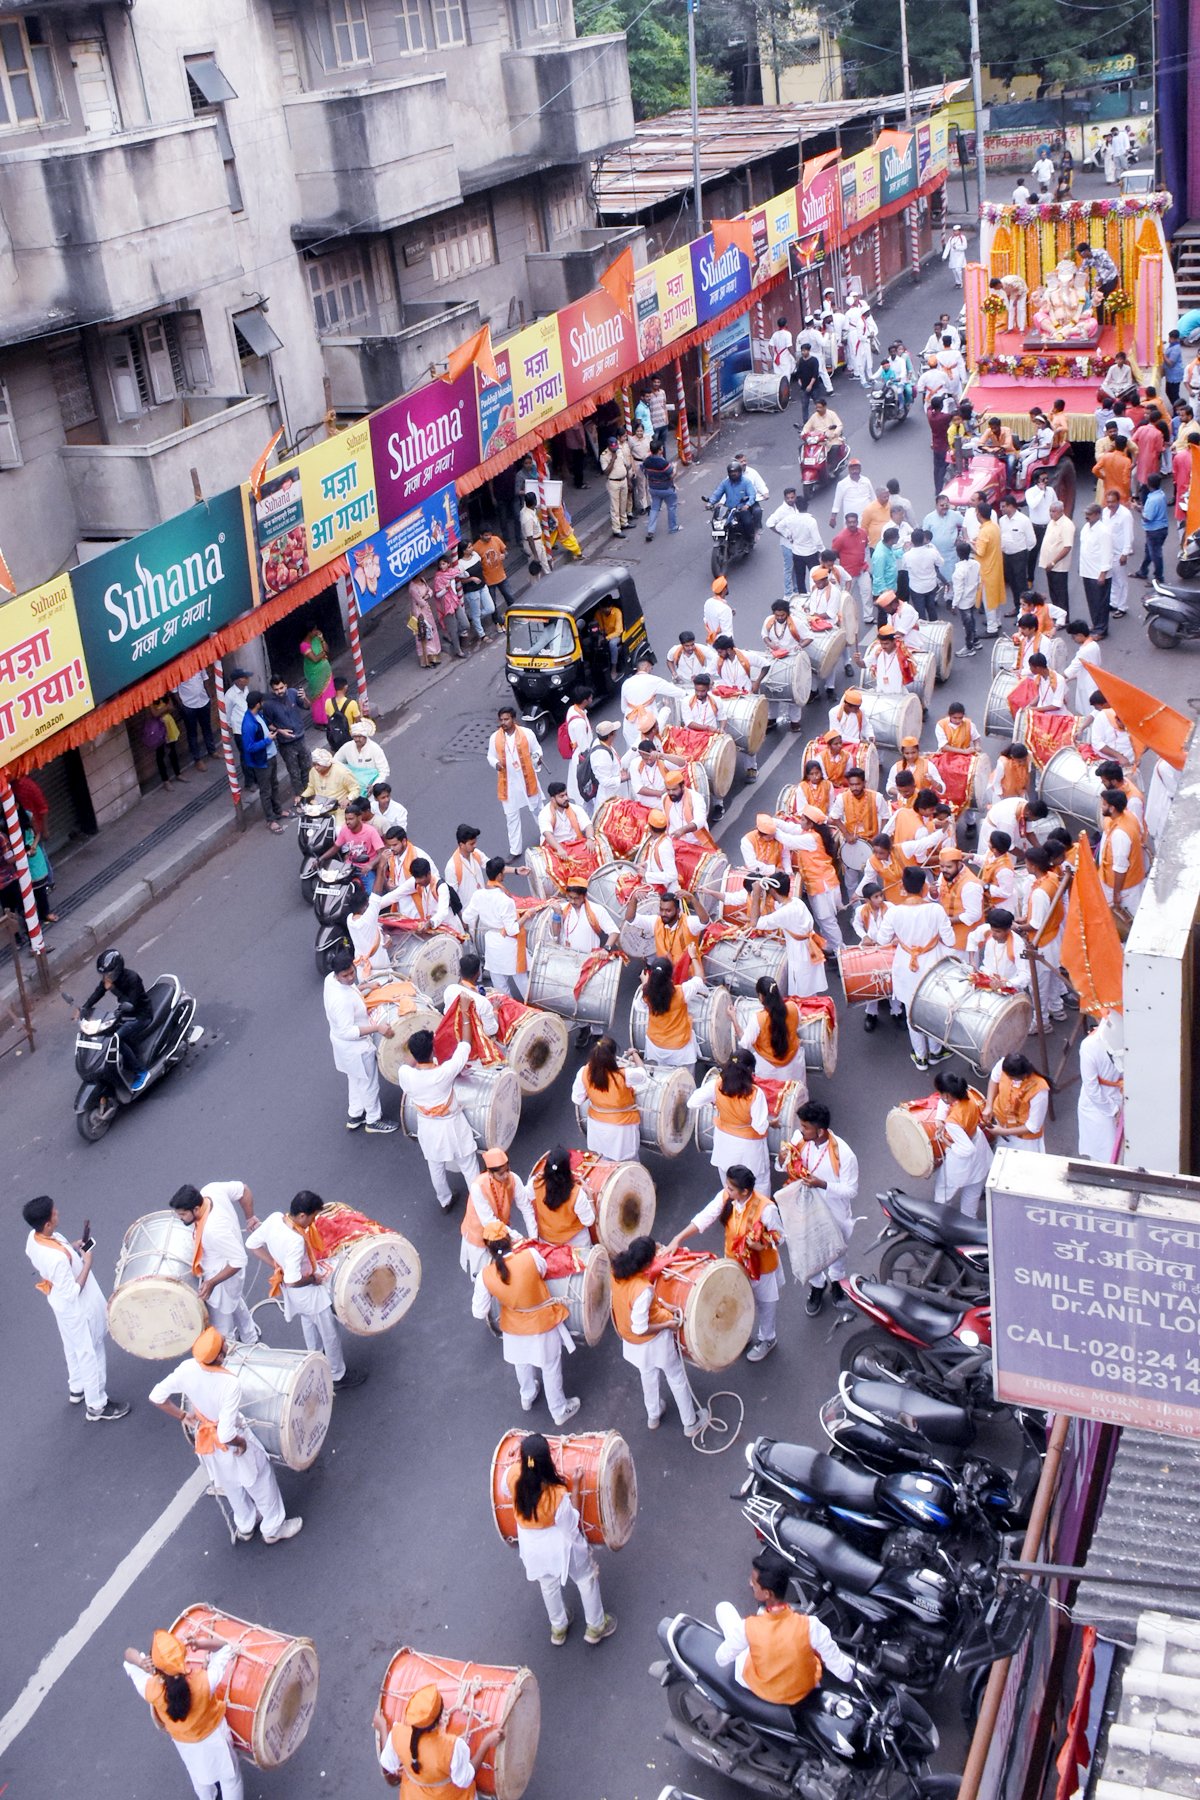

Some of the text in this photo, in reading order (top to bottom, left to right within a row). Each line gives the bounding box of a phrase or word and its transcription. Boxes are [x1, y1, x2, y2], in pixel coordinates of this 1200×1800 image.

[666, 274, 684, 298] मज़ा
[663, 310, 675, 330] आ
[675, 297, 694, 321] गया!
[570, 312, 624, 368] Suhana
[604, 350, 619, 369] गया!
[524, 348, 549, 379] मज़ा
[518, 389, 534, 418] आ
[535, 373, 562, 407] गया!
[388, 410, 463, 480] Suhana
[321, 462, 357, 500] मज़ा
[404, 449, 454, 497] मज़ा आ गया!
[311, 514, 334, 549] आ
[336, 490, 375, 531] गया!
[387, 529, 431, 577] सकाळ
[31, 588, 68, 617] Suhana
[104, 543, 225, 643] Suhana
[131, 594, 212, 661] मज़ा आ गया!
[17, 658, 85, 719] गया!
[35, 712, 64, 737] amazon
[1024, 1205, 1137, 1239] दातांचा
[1052, 1239, 1196, 1281] डॉ.अनिल
[1014, 1267, 1095, 1296] SMILE
[1103, 1282, 1200, 1314] DENTA
[1052, 1294, 1200, 1335] Dr.ANIL LO
[1023, 1378, 1085, 1398] TIMING:
